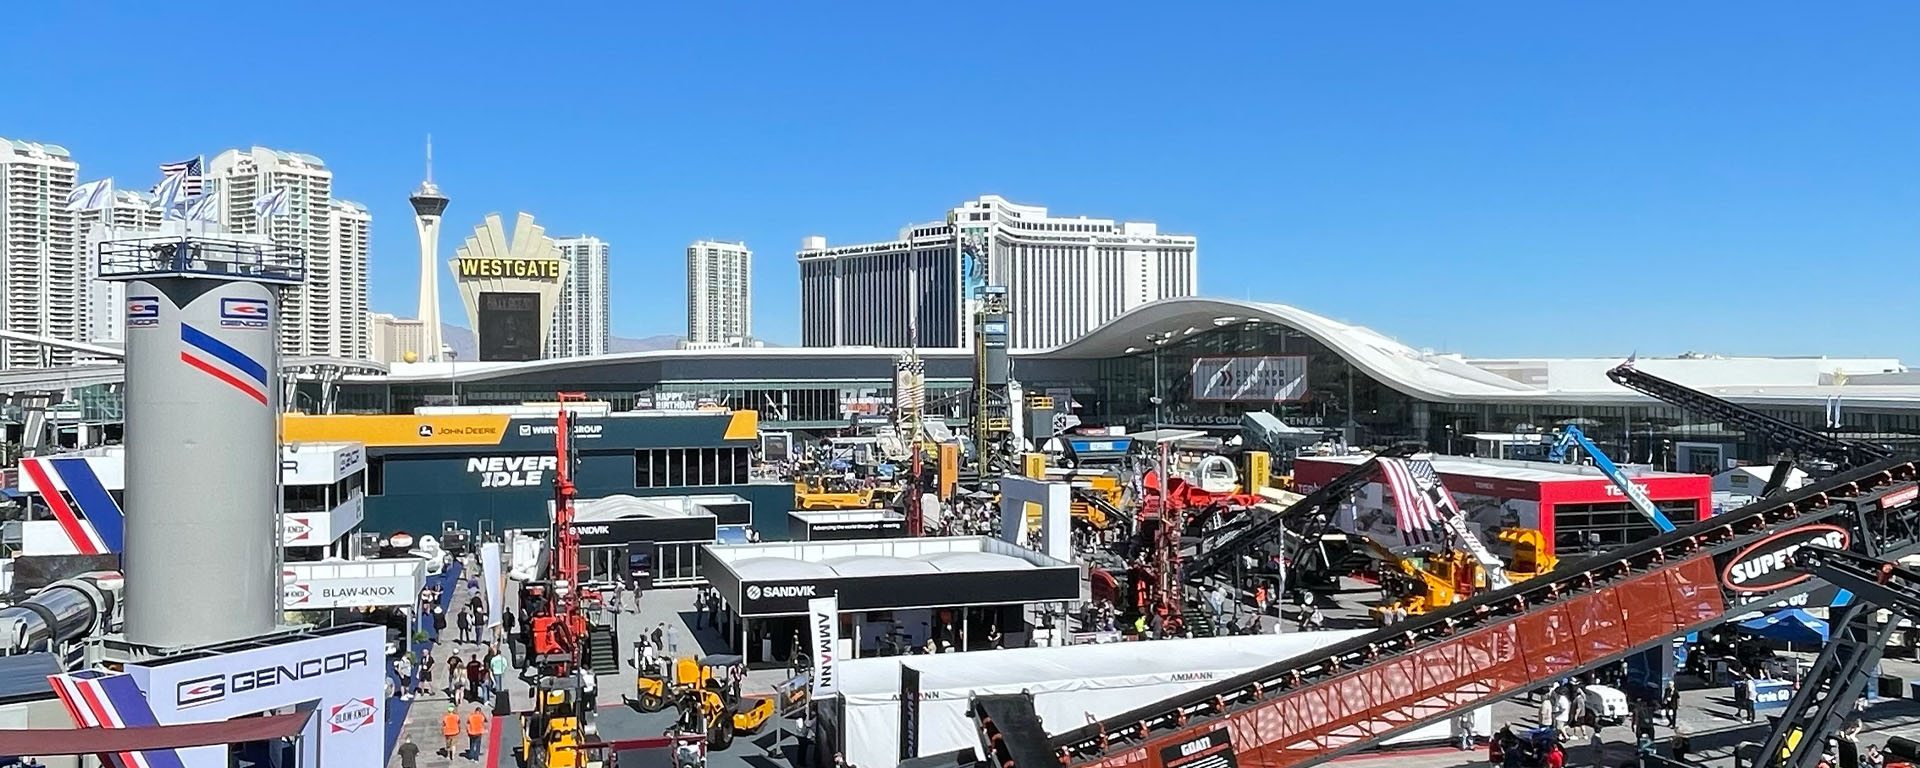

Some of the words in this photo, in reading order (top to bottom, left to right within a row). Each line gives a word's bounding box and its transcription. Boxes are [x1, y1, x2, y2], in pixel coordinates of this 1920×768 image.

[461, 259, 559, 277] WESTGATE
[656, 393, 683, 401] HAPPY
[656, 401, 696, 409] BIRTHDAY
[1282, 416, 1323, 426] CENTER
[438, 427, 464, 435] JOHN
[465, 427, 496, 435] DEERE
[532, 426, 558, 434] WIRTG
[467, 456, 557, 472] NEVER
[481, 471, 543, 487] IDLE
[1604, 484, 1648, 496] TEX
[569, 526, 609, 535] SANDVIK
[1731, 531, 1844, 584] SUPERR
[323, 586, 395, 598] BLAW-KNOX
[763, 586, 816, 597] SANDVIK
[818, 612, 832, 687] AMMANN
[232, 649, 367, 693] GENCOR
[1171, 672, 1213, 682] AMMANN
[892, 691, 940, 701] AANN
